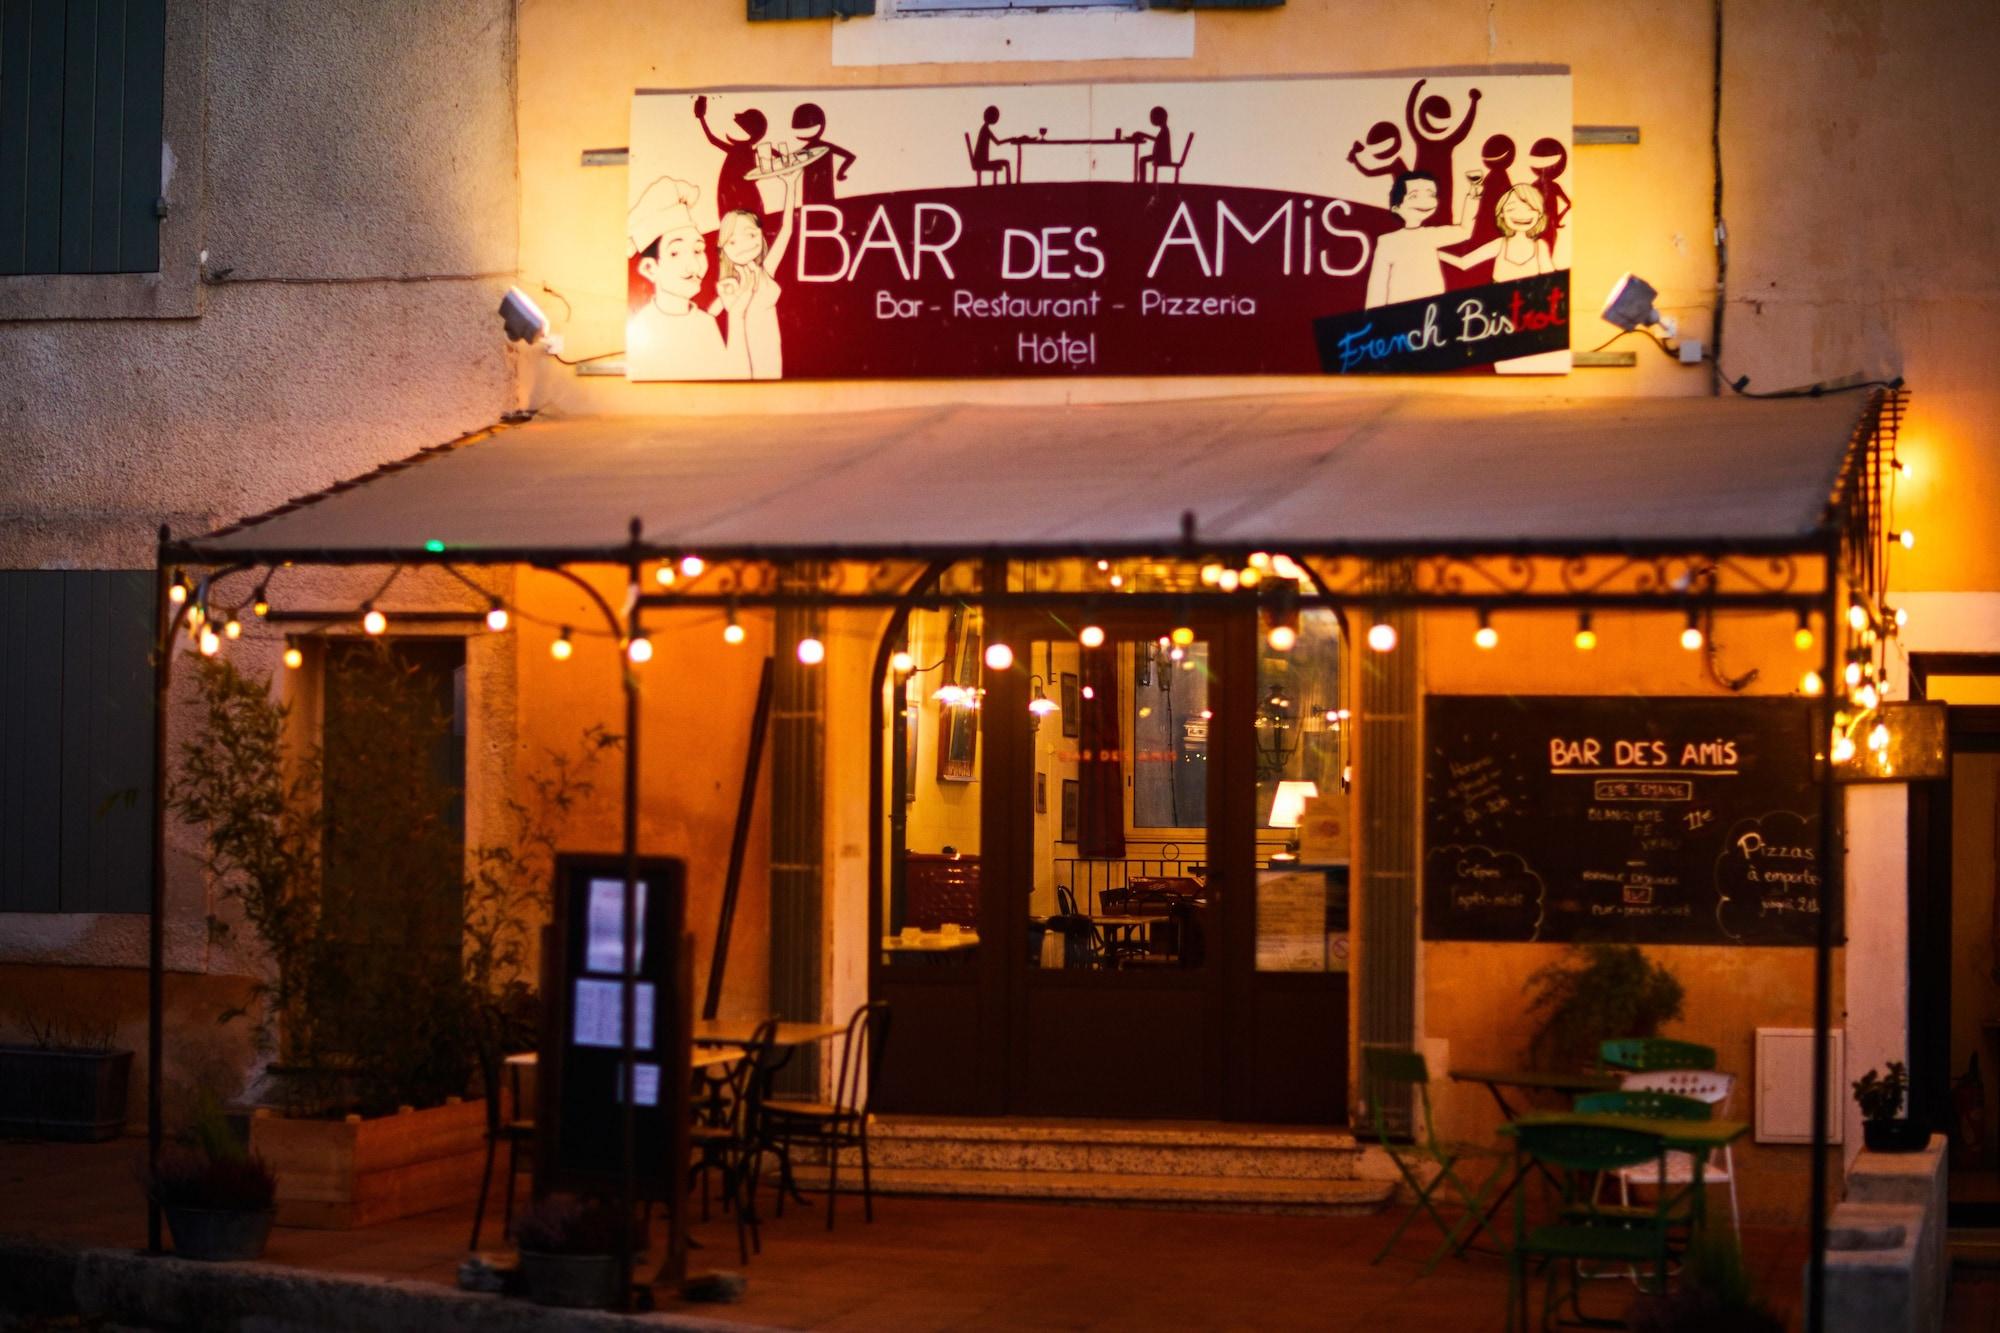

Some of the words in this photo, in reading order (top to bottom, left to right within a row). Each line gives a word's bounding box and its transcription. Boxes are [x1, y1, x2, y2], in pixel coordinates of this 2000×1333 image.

[797, 203, 963, 282] BAR
[1001, 226, 1105, 280] DES
[876, 290, 923, 319] Bar
[953, 289, 1100, 318] Restaurant
[1141, 288, 1256, 317] Pizzeria
[1336, 303, 1447, 374] French
[1456, 286, 1566, 343] Bistrot
[1017, 331, 1096, 364] Hôtel
[1550, 738, 1600, 766] BAR
[1614, 740, 1668, 766] DES
[1737, 831, 1816, 860] Pizzas
